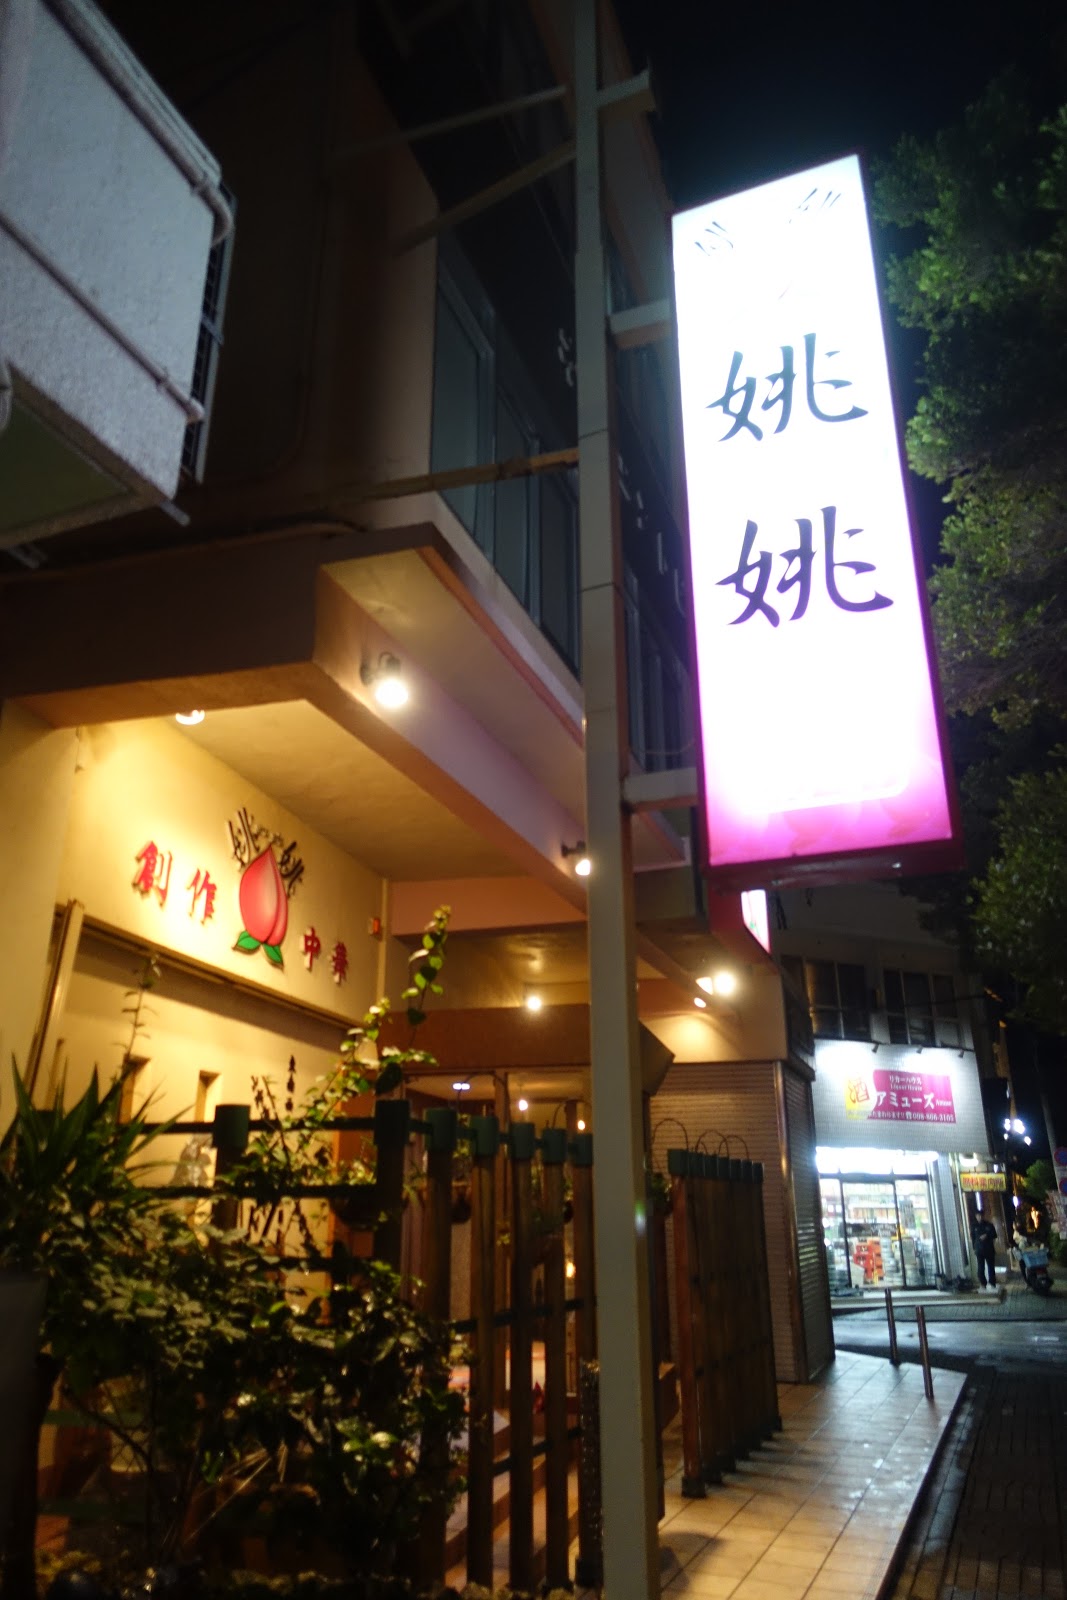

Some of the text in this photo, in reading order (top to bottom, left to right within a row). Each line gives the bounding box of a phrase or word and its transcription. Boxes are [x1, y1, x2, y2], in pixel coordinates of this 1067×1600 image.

[132, 841, 218, 925] 創作
[876, 1091, 935, 1110] アミューズ
